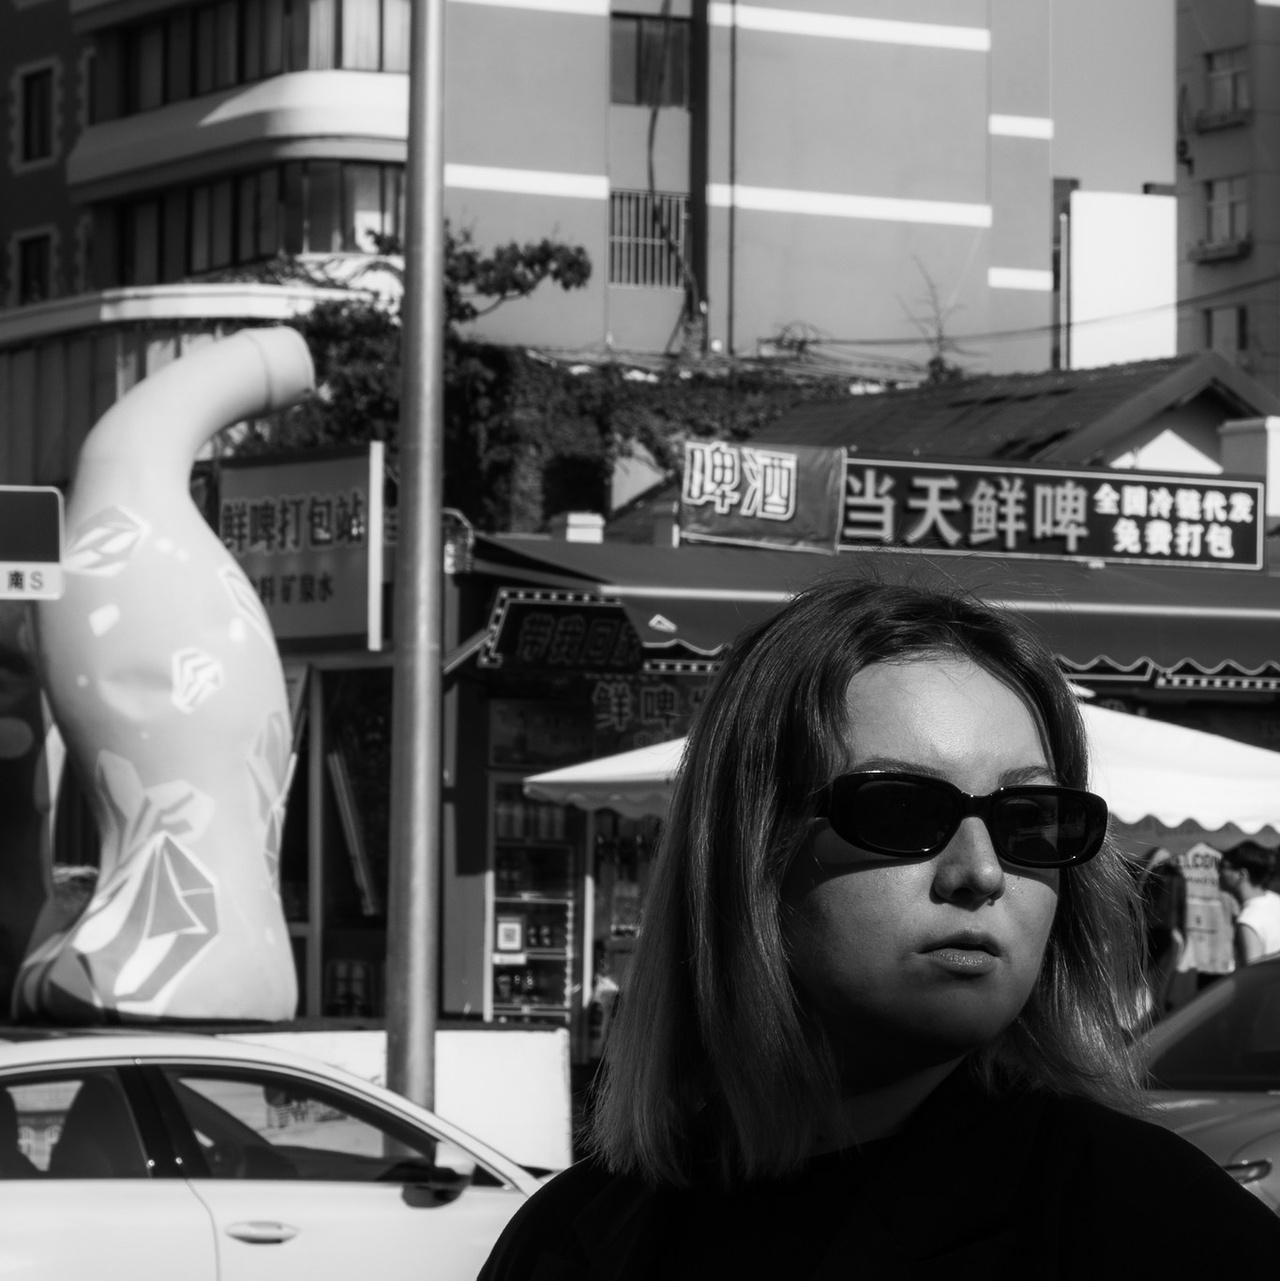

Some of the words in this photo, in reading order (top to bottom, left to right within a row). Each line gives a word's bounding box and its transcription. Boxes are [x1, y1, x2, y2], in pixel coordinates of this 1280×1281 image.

[682, 440, 797, 521] 啤酒
[222, 490, 364, 554] 鲜啤打包站
[844, 468, 1090, 553] 当天鲜啤
[1112, 516, 1235, 559] 免费打包
[9, 570, 25, 589] 南
[30, 570, 43, 589] S
[252, 573, 333, 605] 料矿泉水
[593, 681, 707, 733] 鲜啤
